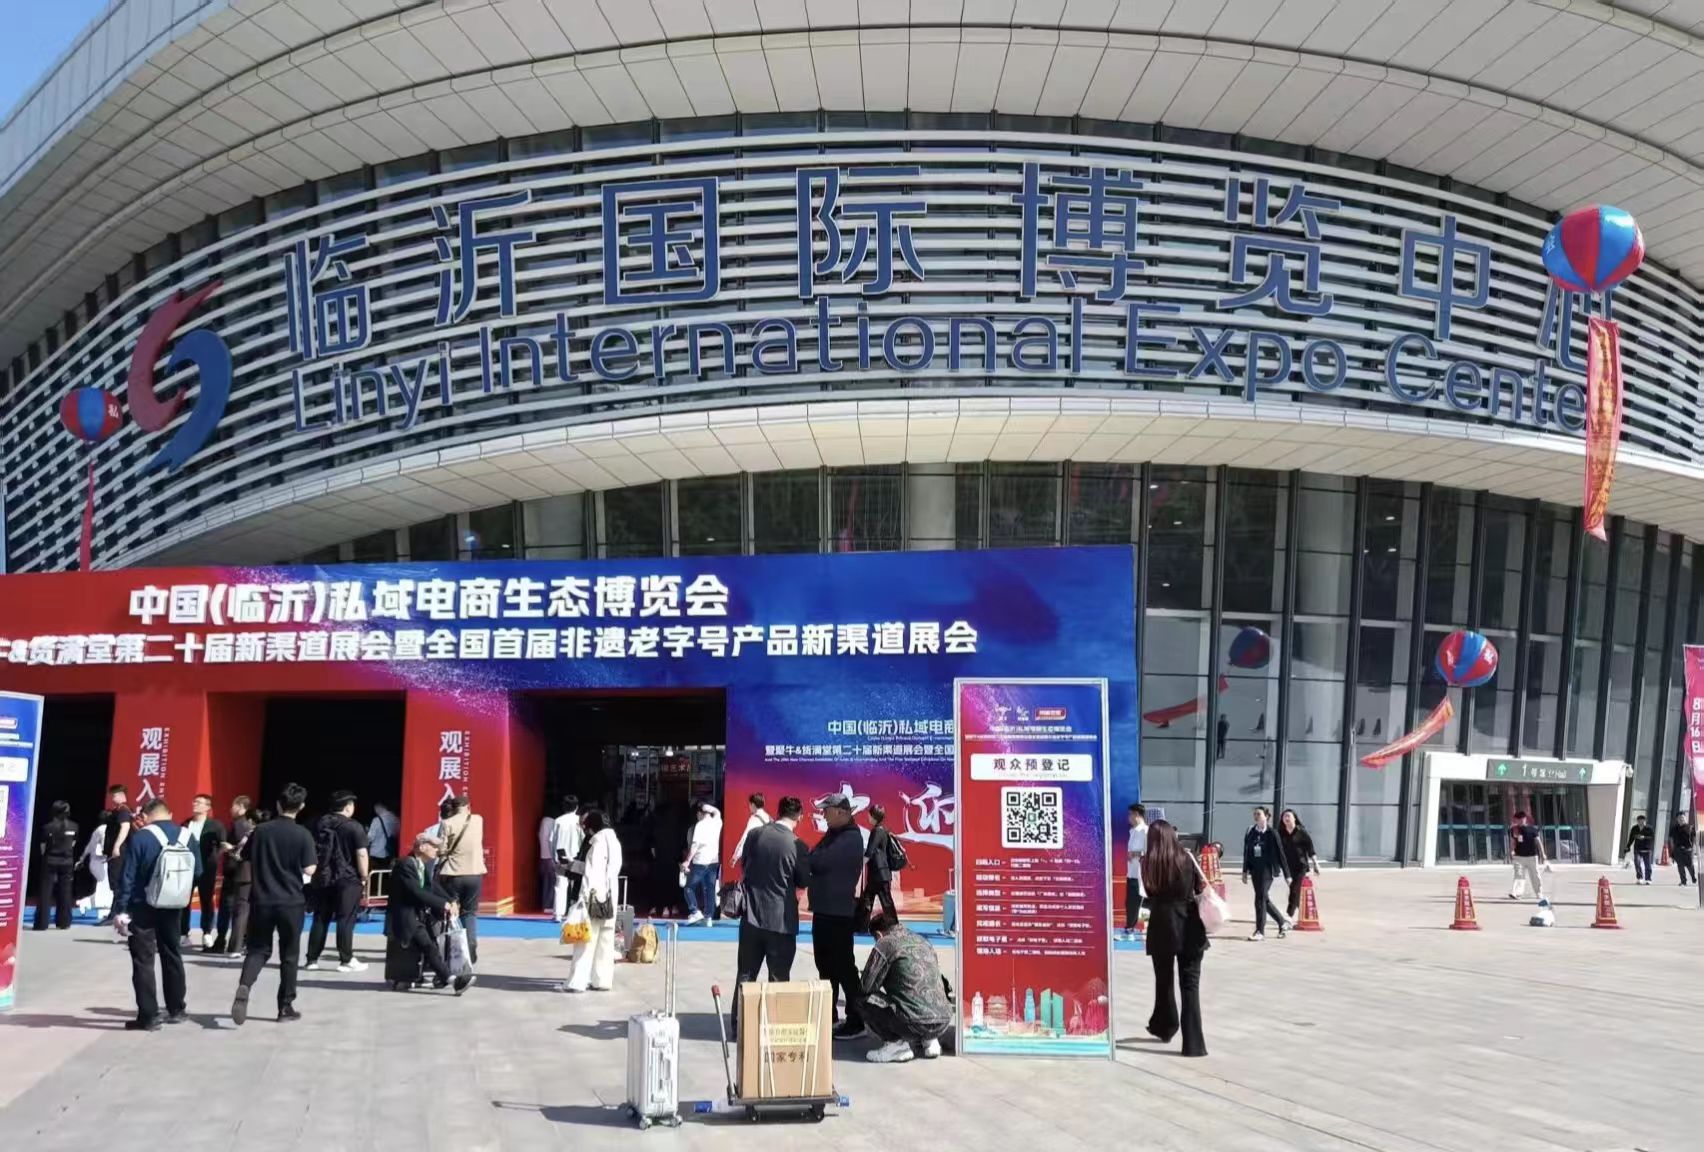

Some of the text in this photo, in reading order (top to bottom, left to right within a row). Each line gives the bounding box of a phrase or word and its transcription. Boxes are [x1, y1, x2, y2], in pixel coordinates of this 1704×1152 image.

[292, 340, 452, 434] Linyi
[479, 296, 1083, 395] International
[1125, 302, 1349, 402] Expo
[1384, 332, 1588, 433] Cente
[128, 573, 729, 626] 中国(临沂)私域电商生态博览会
[135, 727, 163, 820] 观展入
[160, 727, 171, 779] EXHIBITION
[437, 730, 463, 821] 观展入
[462, 730, 471, 782] EXHIBITION
[993, 758, 1070, 771] 观众预登记
